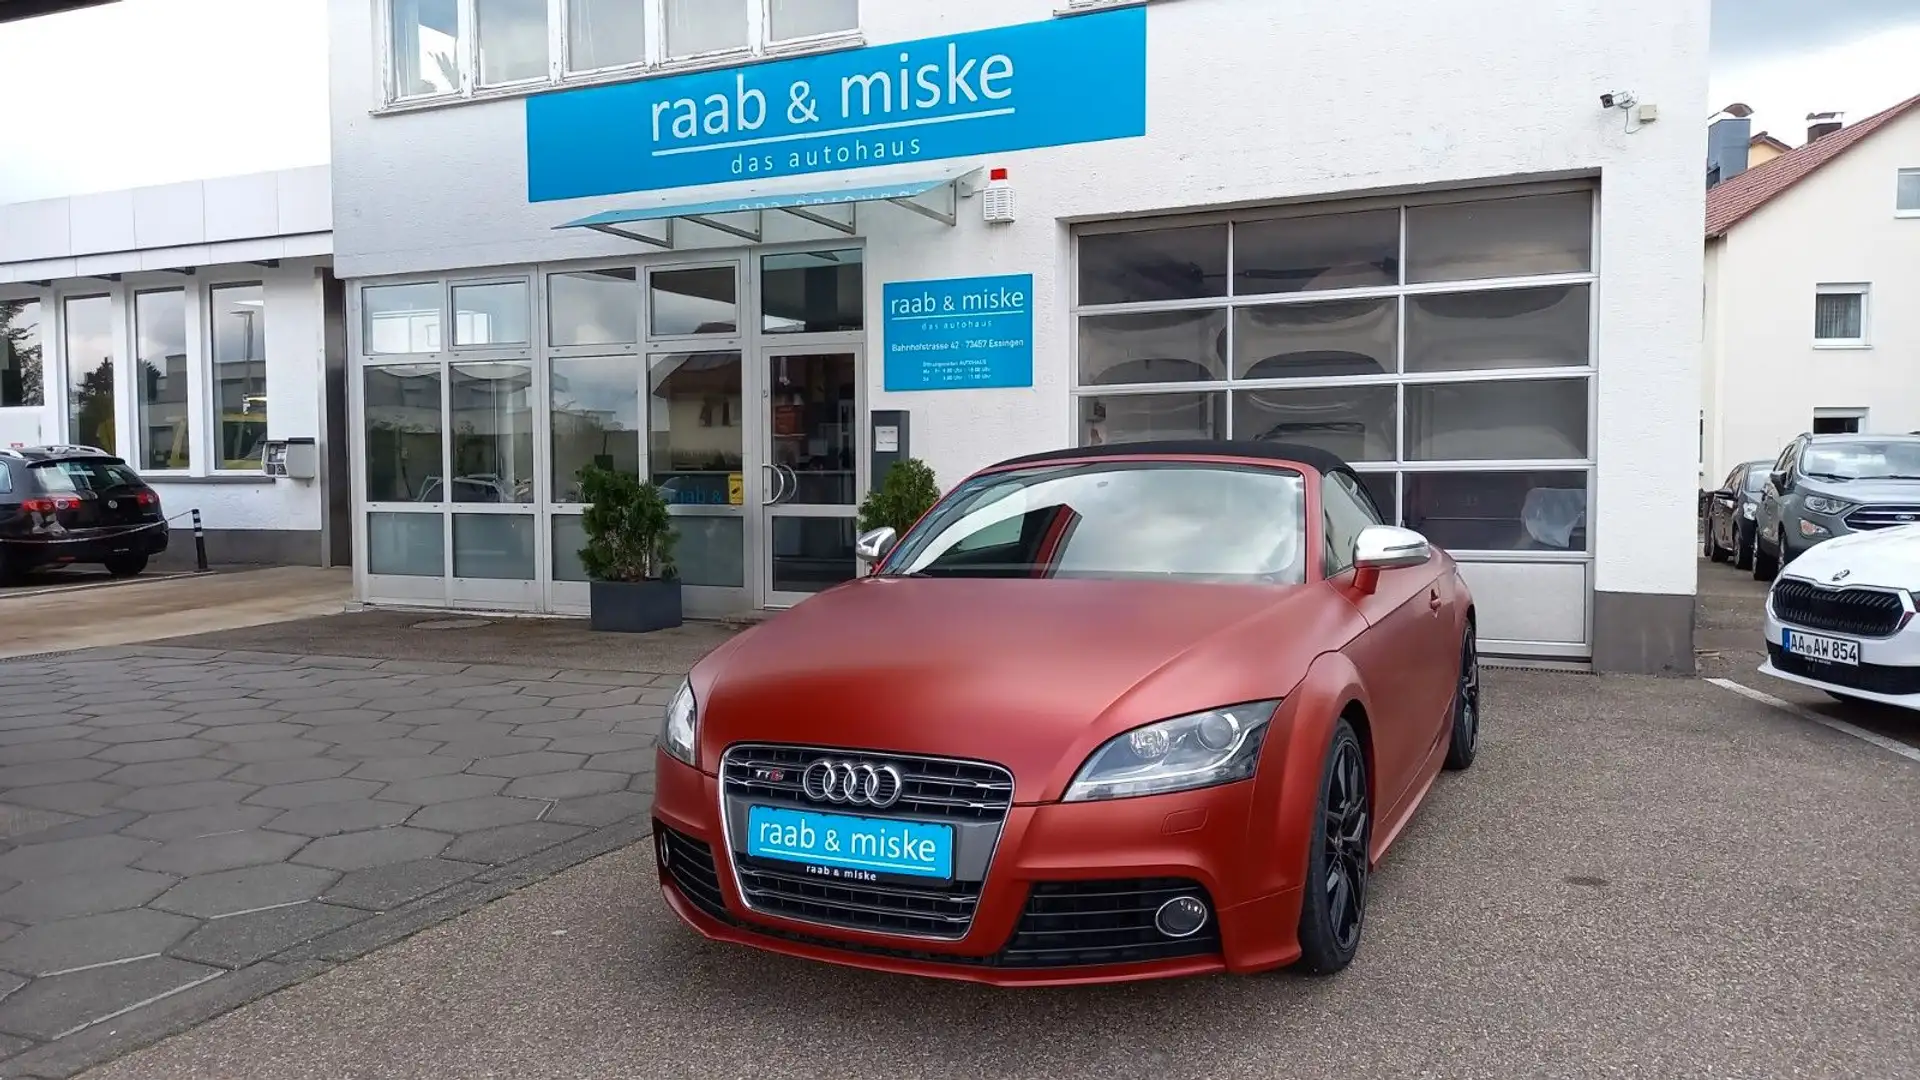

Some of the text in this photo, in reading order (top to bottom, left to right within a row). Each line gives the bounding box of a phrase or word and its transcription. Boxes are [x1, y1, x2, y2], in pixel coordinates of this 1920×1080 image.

[652, 42, 1014, 142] raab & miske
[731, 138, 921, 174] das autohaus
[891, 287, 1024, 315] raab & miske
[921, 320, 992, 331] das autohaus
[891, 342, 949, 352] Bahnhofstrasse
[988, 339, 1024, 349] Essingen
[1791, 633, 1805, 653] AA
[1813, 638, 1829, 657] AW
[1832, 641, 1857, 662] 854
[760, 818, 936, 862] raab & miske
[806, 864, 832, 876] raab
[844, 870, 877, 881] miske
